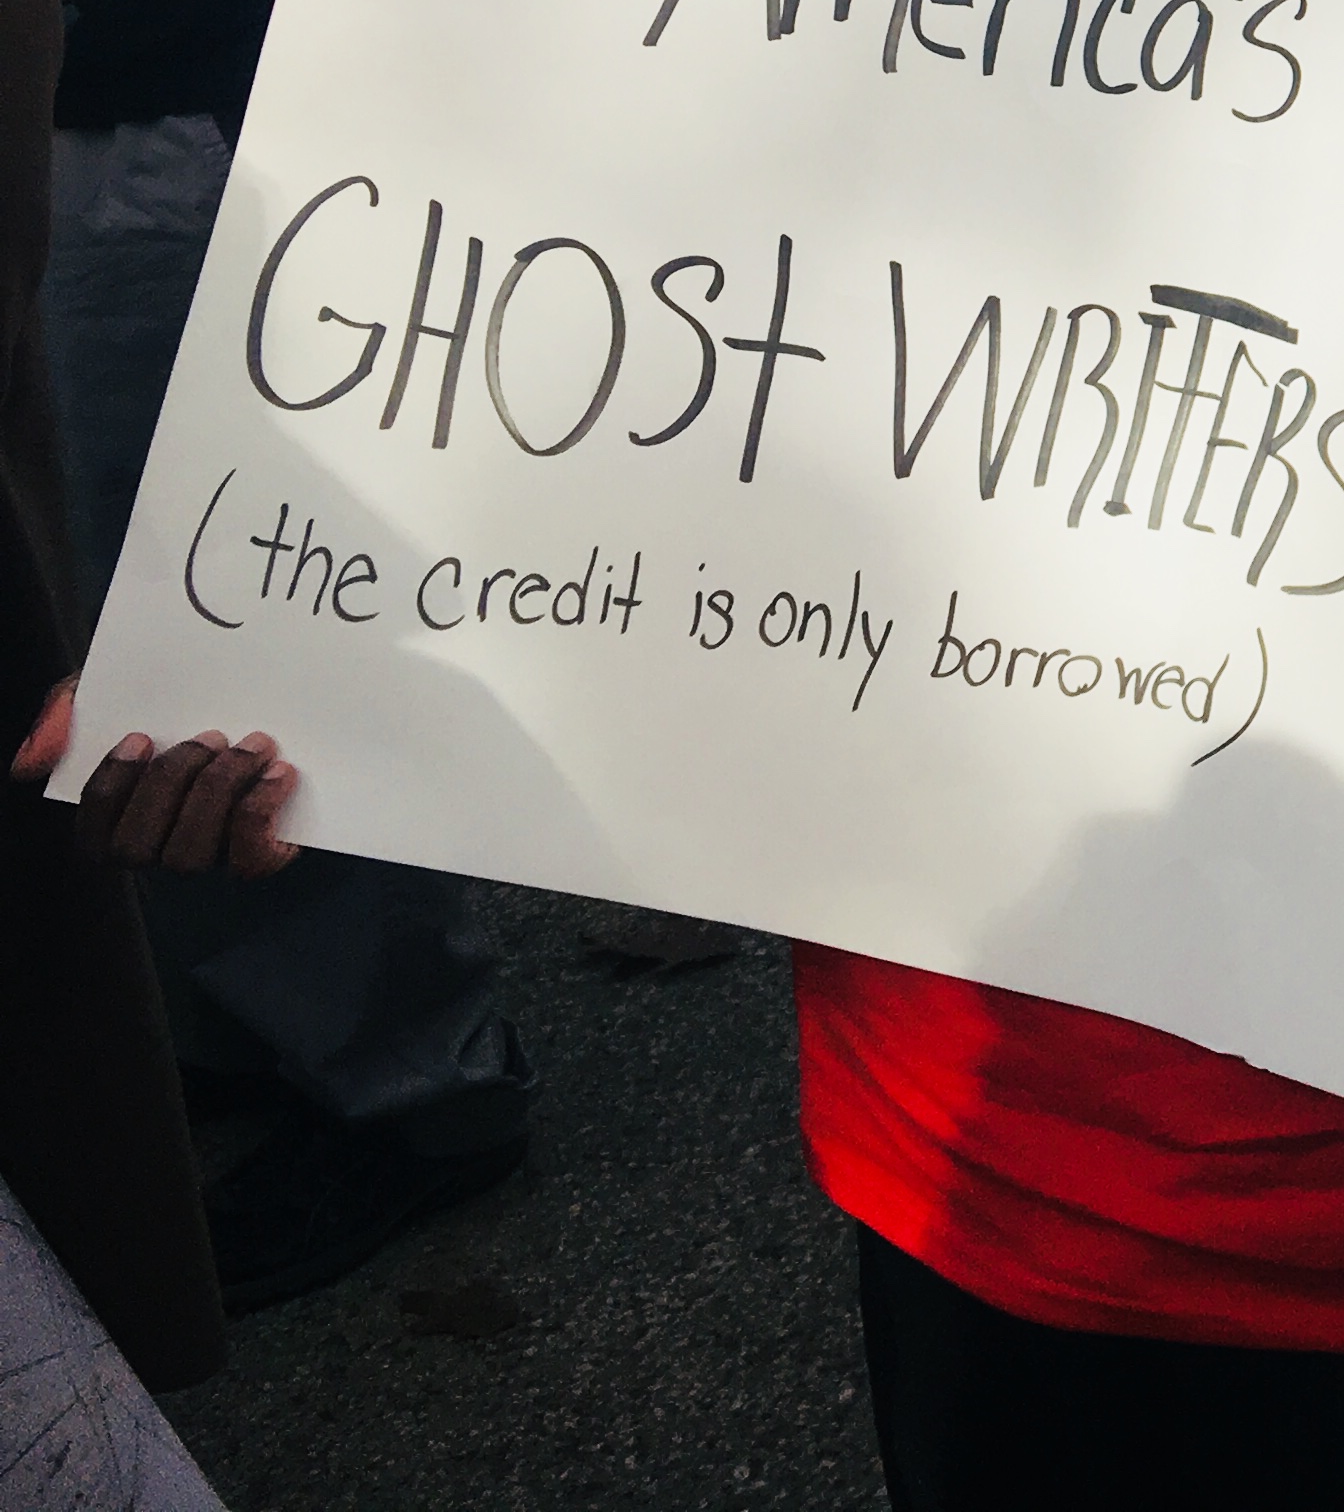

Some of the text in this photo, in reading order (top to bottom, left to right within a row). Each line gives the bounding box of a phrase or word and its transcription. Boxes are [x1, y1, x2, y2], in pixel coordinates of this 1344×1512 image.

[183, 468, 1269, 767] (the credit is only borrowed)
